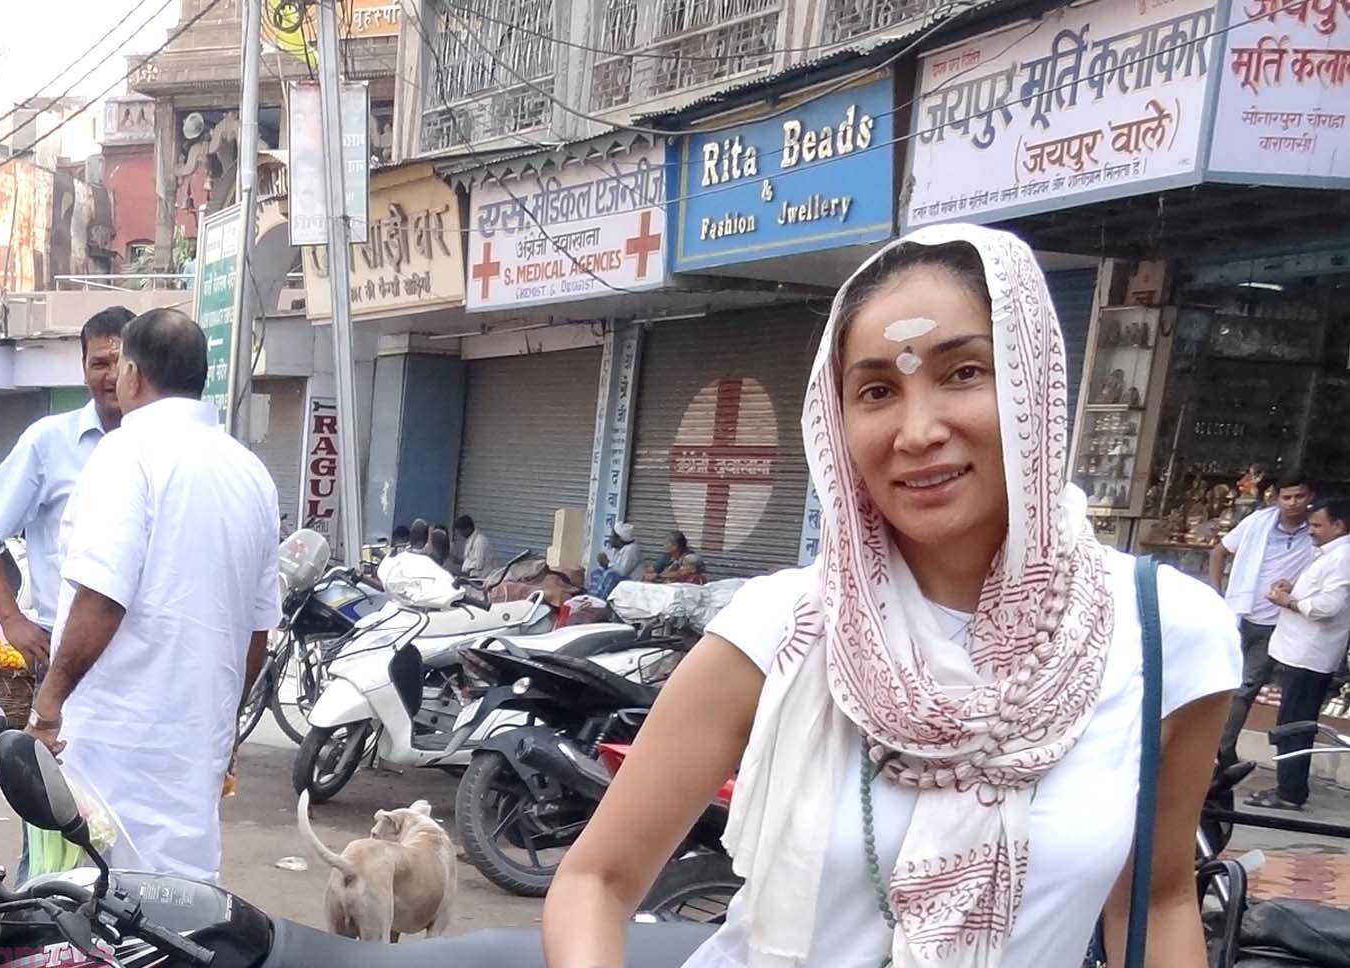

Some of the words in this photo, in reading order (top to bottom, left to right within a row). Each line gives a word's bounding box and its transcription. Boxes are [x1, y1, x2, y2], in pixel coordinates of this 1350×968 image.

[918, 61, 1013, 149] जयपुर
[1019, 24, 1090, 129] मूर्ति
[1089, 8, 1214, 101] कलाकार
[1231, 35, 1290, 96] मूर्ति
[1291, 48, 1350, 90] कला
[701, 136, 757, 186] Rita
[780, 104, 874, 169] Beads
[700, 212, 756, 241] Fashion
[777, 193, 853, 223] Jwellery
[761, 179, 774, 202] &
[504, 269, 515, 286] S.
[516, 261, 565, 285] MEDICAL
[570, 249, 622, 276] AGENCIES
[306, 414, 338, 519] RAGUL
